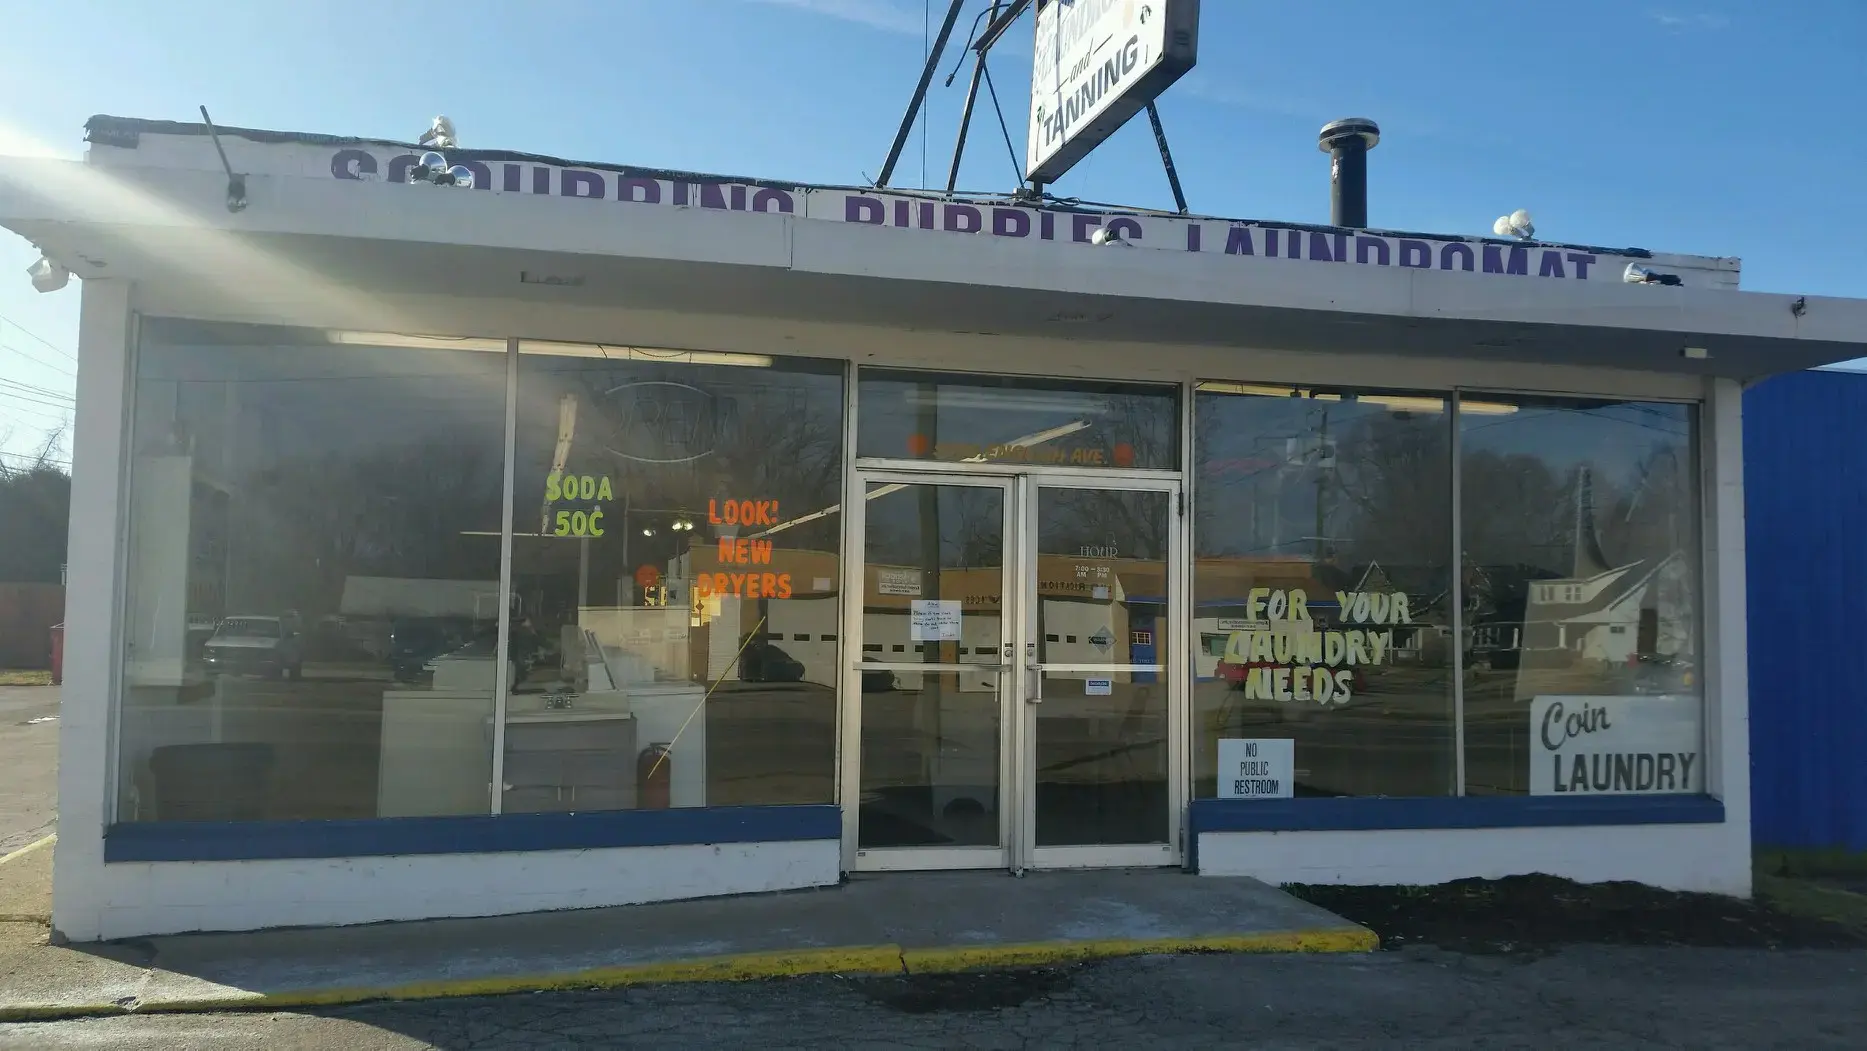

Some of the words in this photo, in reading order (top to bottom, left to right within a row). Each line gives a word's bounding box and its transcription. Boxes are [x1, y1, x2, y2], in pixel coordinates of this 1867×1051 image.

[1069, 37, 1094, 83] and
[1043, 34, 1139, 147] TANNING
[546, 475, 613, 501] SODA
[708, 499, 779, 527] LOOK!
[718, 536, 773, 564] NEW
[696, 573, 793, 599] DRYERS
[1246, 587, 1311, 622] FOR
[1335, 589, 1413, 624] YOUR
[1224, 631, 1389, 667] LAUNDRY
[1245, 667, 1354, 705] NEEDS
[1541, 702, 1611, 750] Coin
[1245, 742, 1257, 758] NO
[1240, 761, 1269, 777] PUBLIC
[1554, 752, 1697, 792] LAUNDRY
[1234, 779, 1279, 794] RESTROOM
